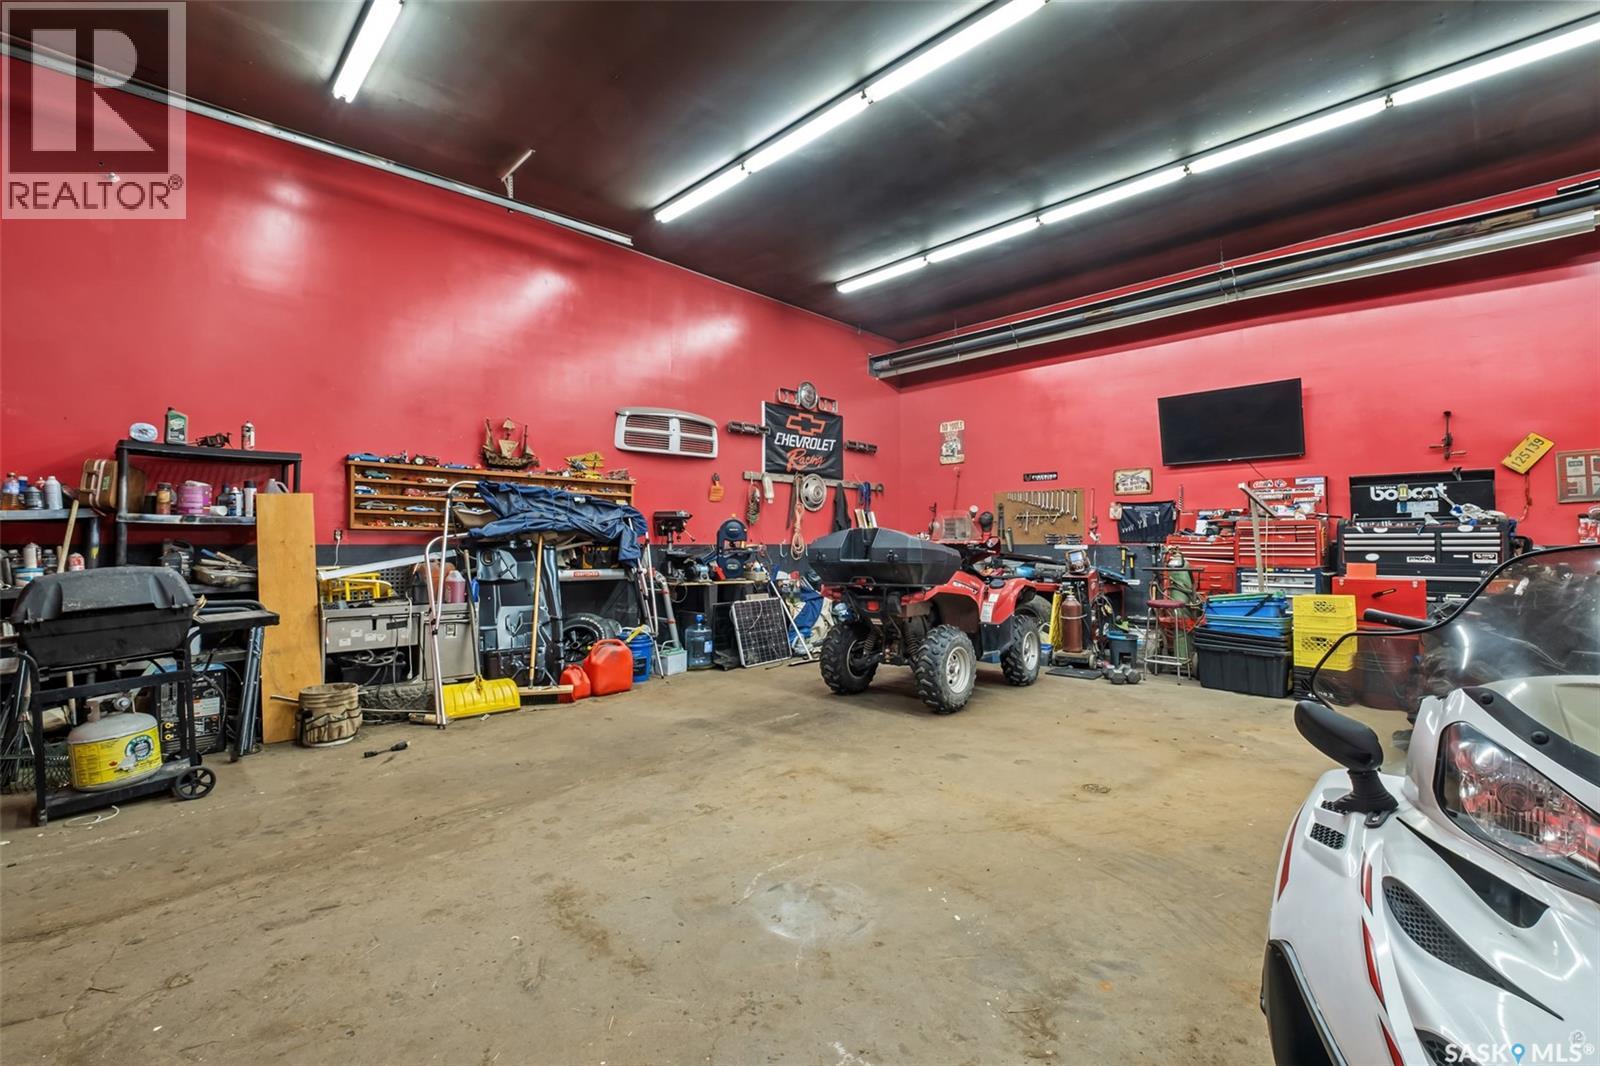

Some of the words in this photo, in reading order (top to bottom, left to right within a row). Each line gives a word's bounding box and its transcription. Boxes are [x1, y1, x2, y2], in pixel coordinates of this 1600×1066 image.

[774, 432, 836, 451] CHEVROLET
[1511, 437, 1541, 468] 125139
[785, 448, 826, 473] Racing
